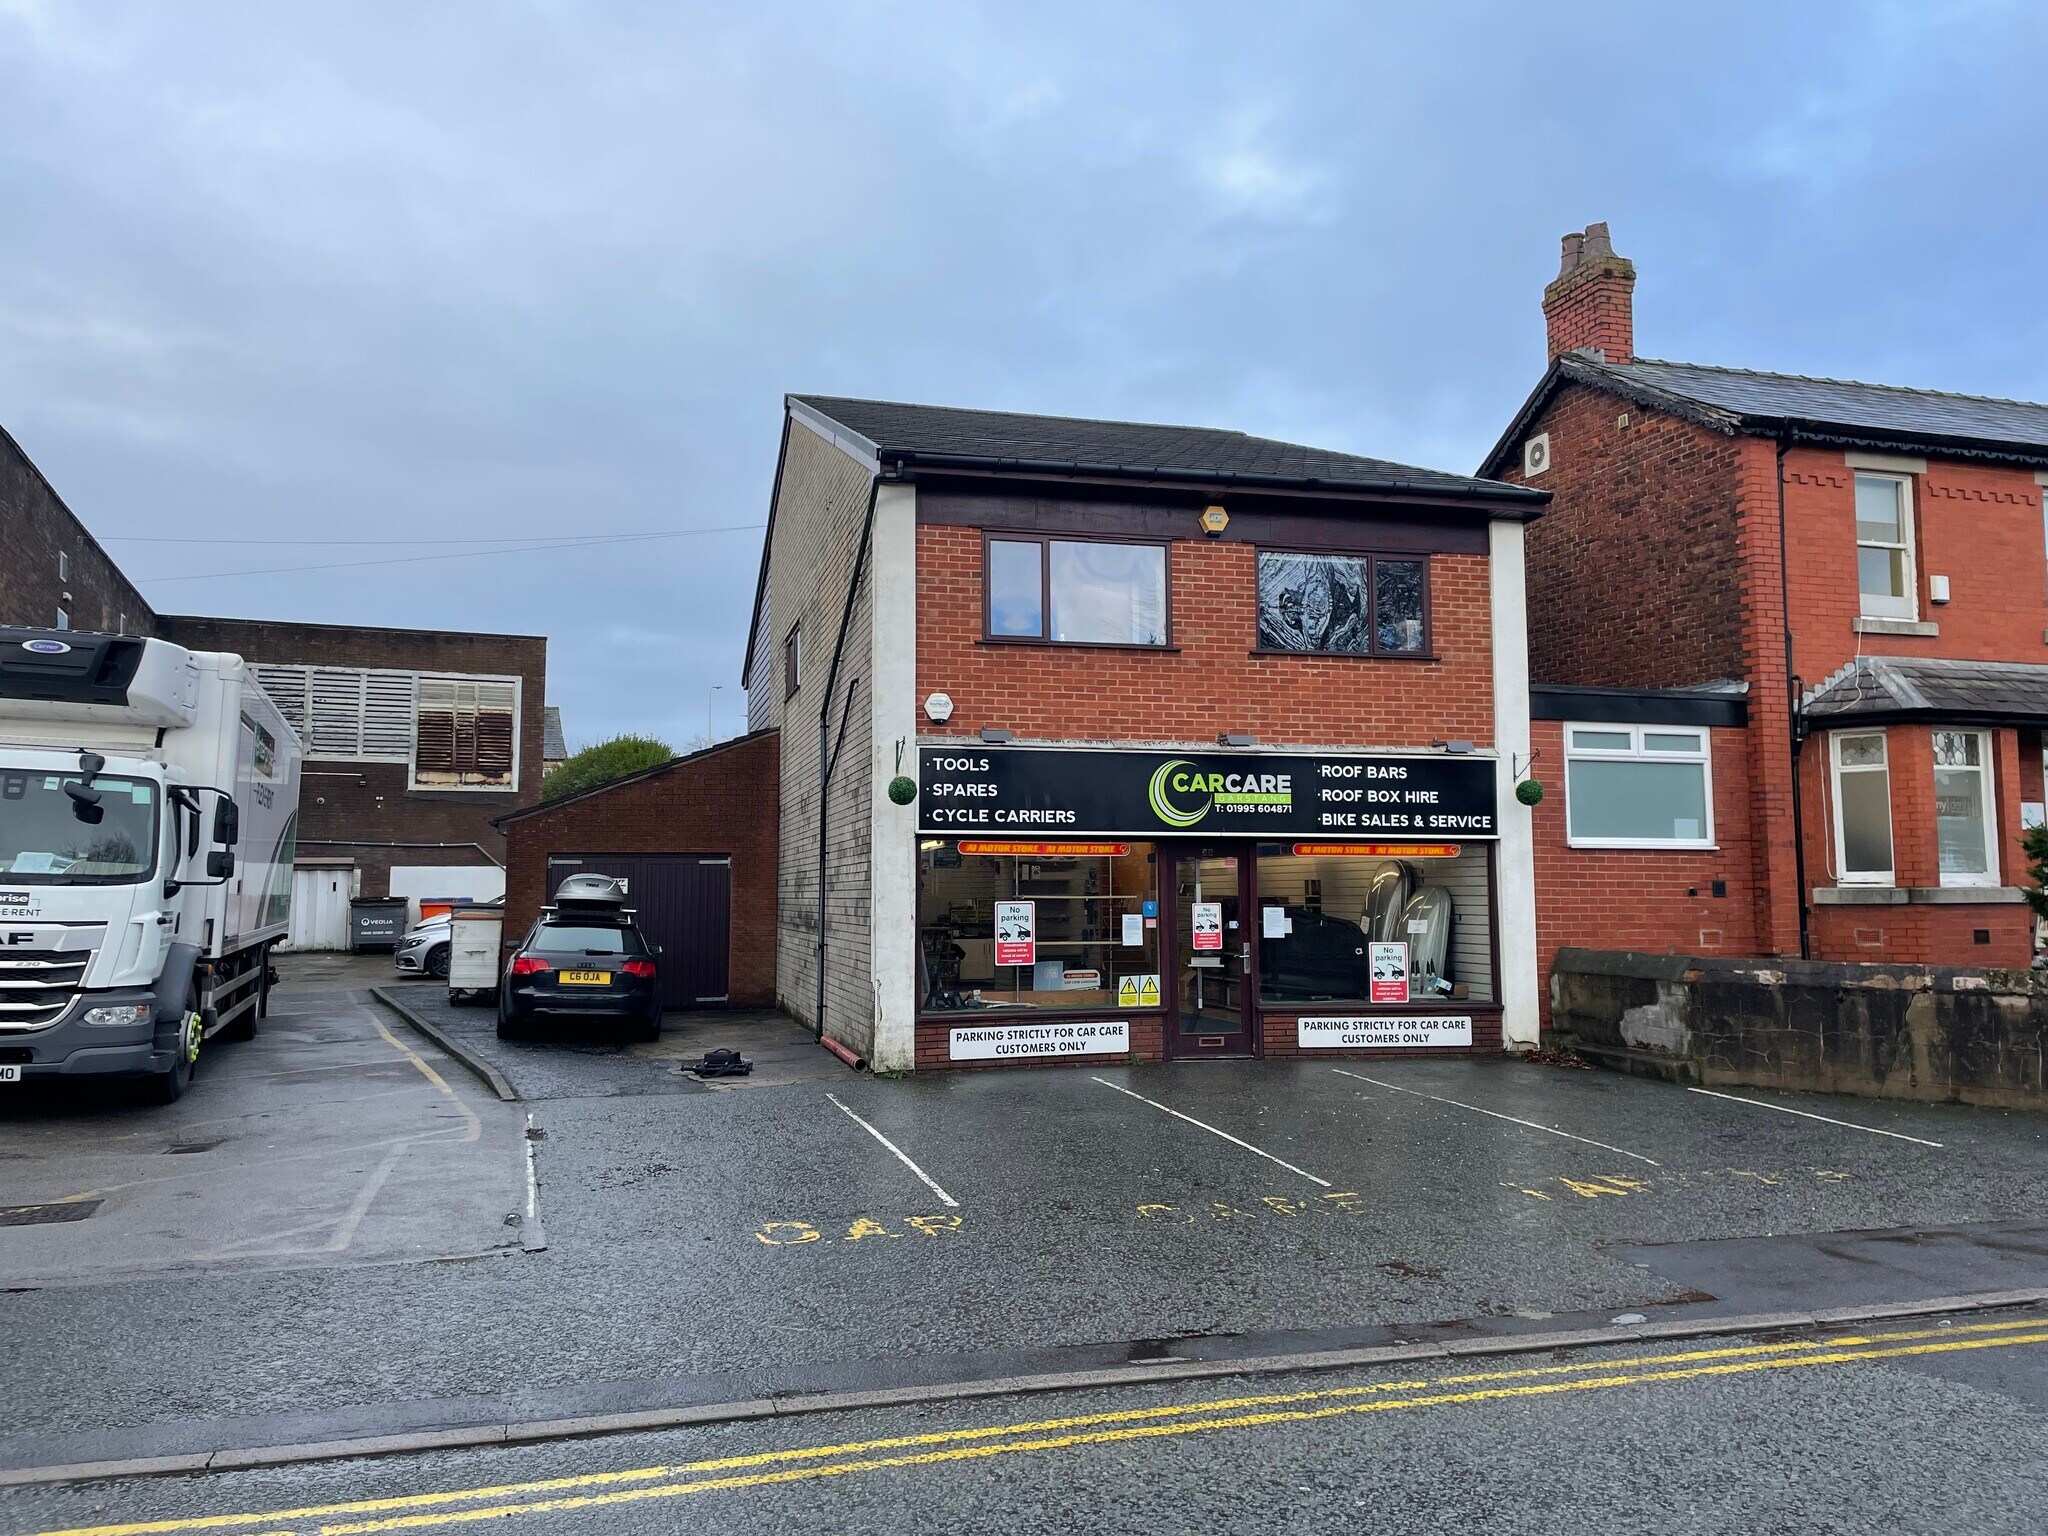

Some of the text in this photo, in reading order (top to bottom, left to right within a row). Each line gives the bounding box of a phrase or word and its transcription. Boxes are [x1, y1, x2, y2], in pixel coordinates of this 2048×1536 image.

[932, 758, 990, 772] TOOLS
[1321, 766, 1408, 779] ROOF BARS
[1172, 773, 1292, 793] CARCARE
[932, 784, 998, 797] SPARES
[1322, 790, 1439, 804] ROOF BOX HIRE
[1218, 794, 1286, 803] GARSTANG
[1226, 804, 1255, 813] 01995
[1258, 805, 1292, 814] 604871
[932, 809, 1076, 824] CYCLE CARRIERS
[1322, 814, 1492, 828] BIKE SALES & SERVICE
[978, 844, 1010, 852] MOTOR
[1012, 844, 1038, 853] STORE
[1057, 844, 1088, 853] MOTOR
[1090, 845, 1114, 853] STORE
[570, 972, 581, 980] C6
[1304, 1020, 1465, 1030] PARKING STRICTLY FOR CAR CARE
[956, 1026, 1123, 1042] PARKING STRICTLY FOR CAR CARE
[1342, 1033, 1430, 1043] CUSTOMERS ONLY
[996, 1041, 1086, 1054] CUSTOMERS ONLY
